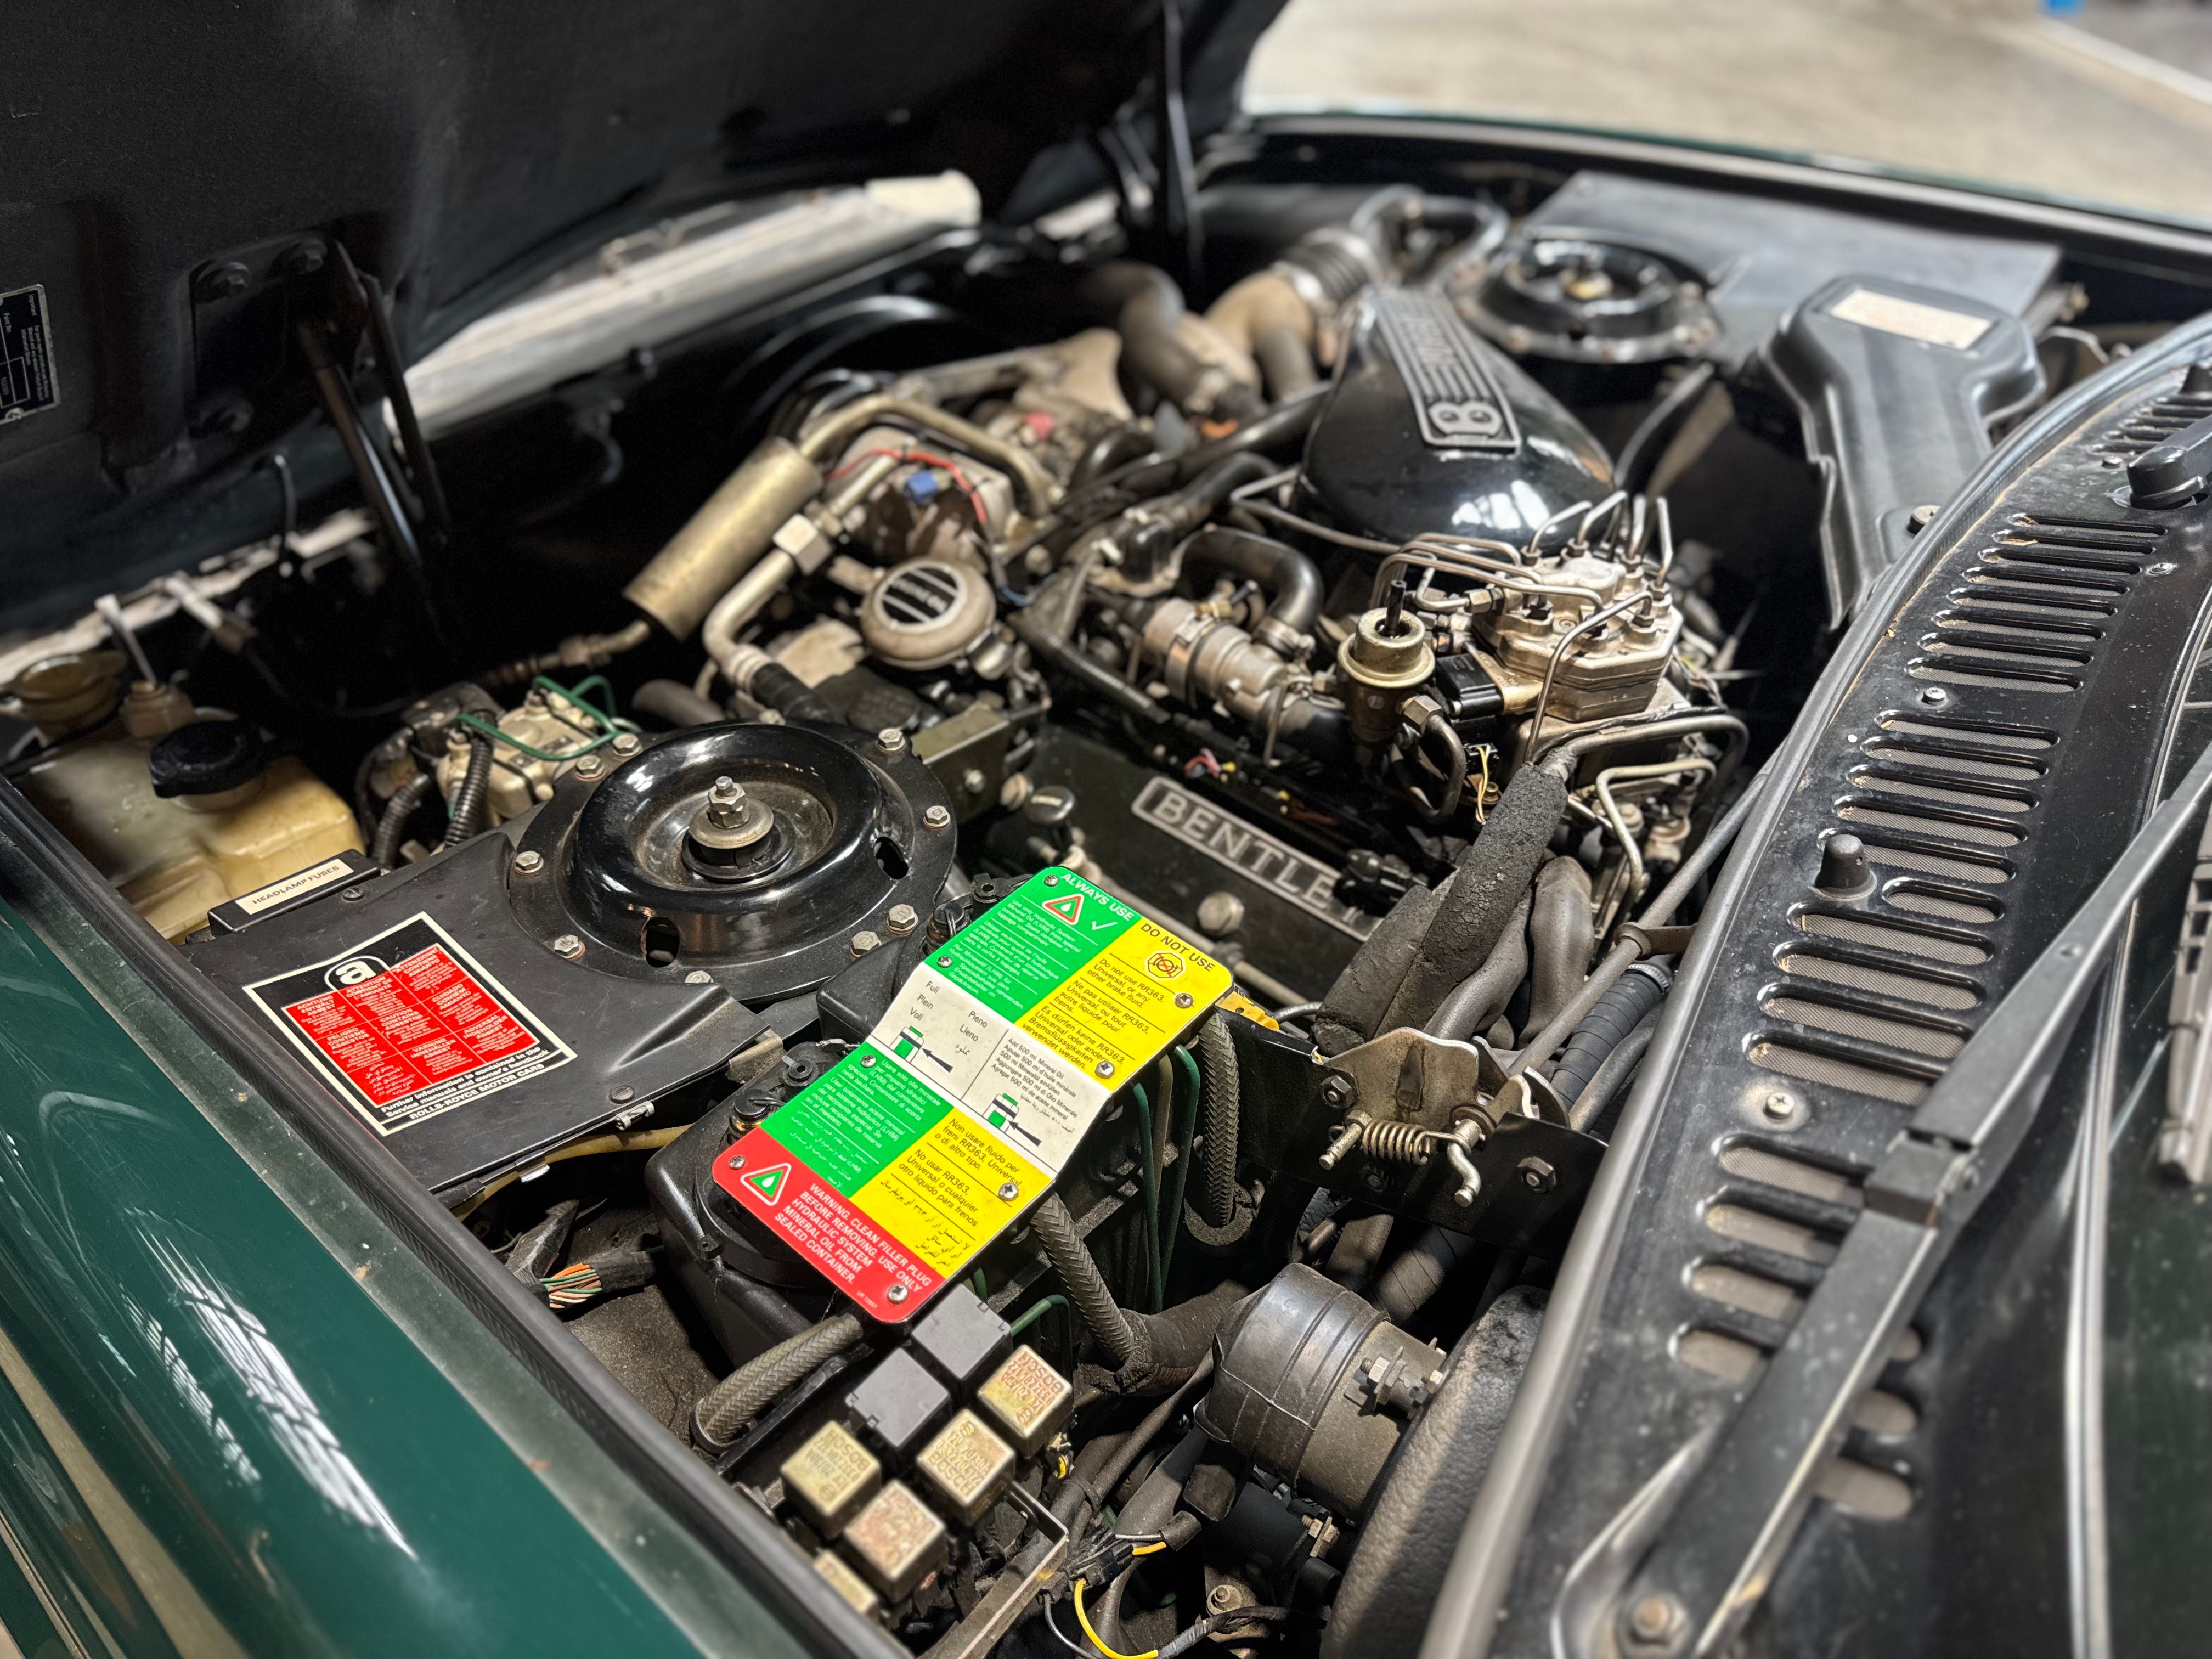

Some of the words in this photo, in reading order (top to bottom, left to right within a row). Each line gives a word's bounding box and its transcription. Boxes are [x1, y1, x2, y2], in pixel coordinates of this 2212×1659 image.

[1153, 789, 1363, 924] BENTLE
[252, 879, 307, 904] HEADLAMP
[308, 866, 339, 881] FUSES
[1060, 873, 1109, 905] ALWAYS
[1109, 902, 1134, 921] USE
[1140, 923, 1160, 937] DO
[1160, 935, 1189, 953] NOT
[1188, 952, 1215, 972] USE
[917, 994, 933, 1009] Plein
[926, 980, 939, 994] Full
[1087, 970, 1106, 982] other
[1105, 981, 1125, 996] brake
[1126, 994, 1144, 1008] fluid.
[1093, 963, 1126, 988] Universal,
[1136, 992, 1150, 1002] any
[1099, 958, 1110, 967] Do
[1110, 967, 1124, 976] not
[1124, 975, 1137, 985] use
[1137, 983, 1164, 1002] RR363,
[910, 1007, 923, 1021] Voll
[968, 1010, 987, 1028] Pieno
[1053, 996, 1073, 1012] freins.
[1059, 991, 1077, 1005] autre
[1078, 1003, 1102, 1020] liquide
[1101, 1020, 1120, 1032] pour
[1066, 985, 1099, 1010] Universal,
[1110, 1015, 1126, 1027] tout
[1073, 980, 1084, 989] Ne
[1082, 989, 1097, 998] pas
[1098, 997, 1121, 1014] utiliser
[1122, 1013, 1149, 1034] RR363,
[959, 1024, 978, 1041] Lleno
[1022, 1023, 1058, 1049] verwendet
[1058, 1048, 1085, 1069] werden.
[1028, 1017, 1093, 1063] Bremsflüssigkeiten
[1035, 1011, 1068, 1035] Universal
[1067, 1034, 1084, 1046] oder
[1041, 1005, 1051, 1014] Es
[1051, 1014, 1075, 1031] dürfen
[1075, 1029, 1096, 1045] keine
[1096, 1042, 1125, 1064] RR363,
[991, 1063, 1010, 1078] Agregar
[1009, 1076, 1022, 1086] 500
[1000, 1050, 1011, 1060] 500
[1007, 1038, 1019, 1047] Add
[1018, 1045, 1030, 1054] 500
[1037, 1058, 1057, 1074] Mineral
[1020, 1056, 1032, 1066] 500
[380, 1097, 413, 1113] Further
[414, 1077, 464, 1099] information
[472, 1055, 517, 1077] contained
[513, 1052, 526, 1060] in
[522, 1045, 542, 1056] the
[386, 1102, 419, 1117] Service
[420, 1087, 457, 1104] manuals
[457, 1079, 475, 1089] and
[508, 1049, 550, 1068] handbook
[409, 1089, 478, 1119] ROLLS-ROYCE
[478, 1074, 517, 1091] MOTOR
[514, 1061, 544, 1076] CARS
[1022, 1075, 1034, 1085] 500
[1046, 1092, 1056, 1102] Olio
[943, 1126, 959, 1141] freni
[958, 1138, 986, 1162] RR363,
[987, 1159, 1022, 1188] Universal
[949, 1118, 964, 1133] Non
[965, 1131, 985, 1147] usare
[985, 1145, 1005, 1163] fluido
[1005, 1162, 1019, 1172] per
[949, 1144, 966, 1157] altro
[966, 1156, 980, 1170] tipo.
[907, 1155, 940, 1183] Universal
[945, 1187, 978, 1212] cualquier
[913, 1149, 926, 1160] No
[926, 1159, 943, 1172] usar
[941, 1170, 969, 1195] RR363,
[899, 1164, 913, 1176] otro
[936, 1194, 954, 1208] para
[954, 1206, 978, 1226] frenos
[774, 1212, 808, 1241] SEALED
[806, 1239, 855, 1283] CONTAINER.
[783, 1205, 820, 1239] MINERAL
[820, 1237, 834, 1251] OIL
[834, 1249, 862, 1272] FROM
[792, 1198, 839, 1238] HYDRAULIC
[837, 1236, 873, 1267] SYSTEM
[800, 1191, 833, 1220] BEFORE
[878, 1255, 898, 1273] USE
[896, 1271, 922, 1291] ONLY
[810, 1183, 850, 1220] WARNING.
[850, 1218, 880, 1243] CLEAN
[878, 1240, 908, 1266] FILLER
[906, 1264, 932, 1286] PLUG
[1018, 1352, 1064, 1395] BOSCH
[825, 1429, 869, 1470] BOSCH
[927, 1451, 975, 1495] BOSCH
